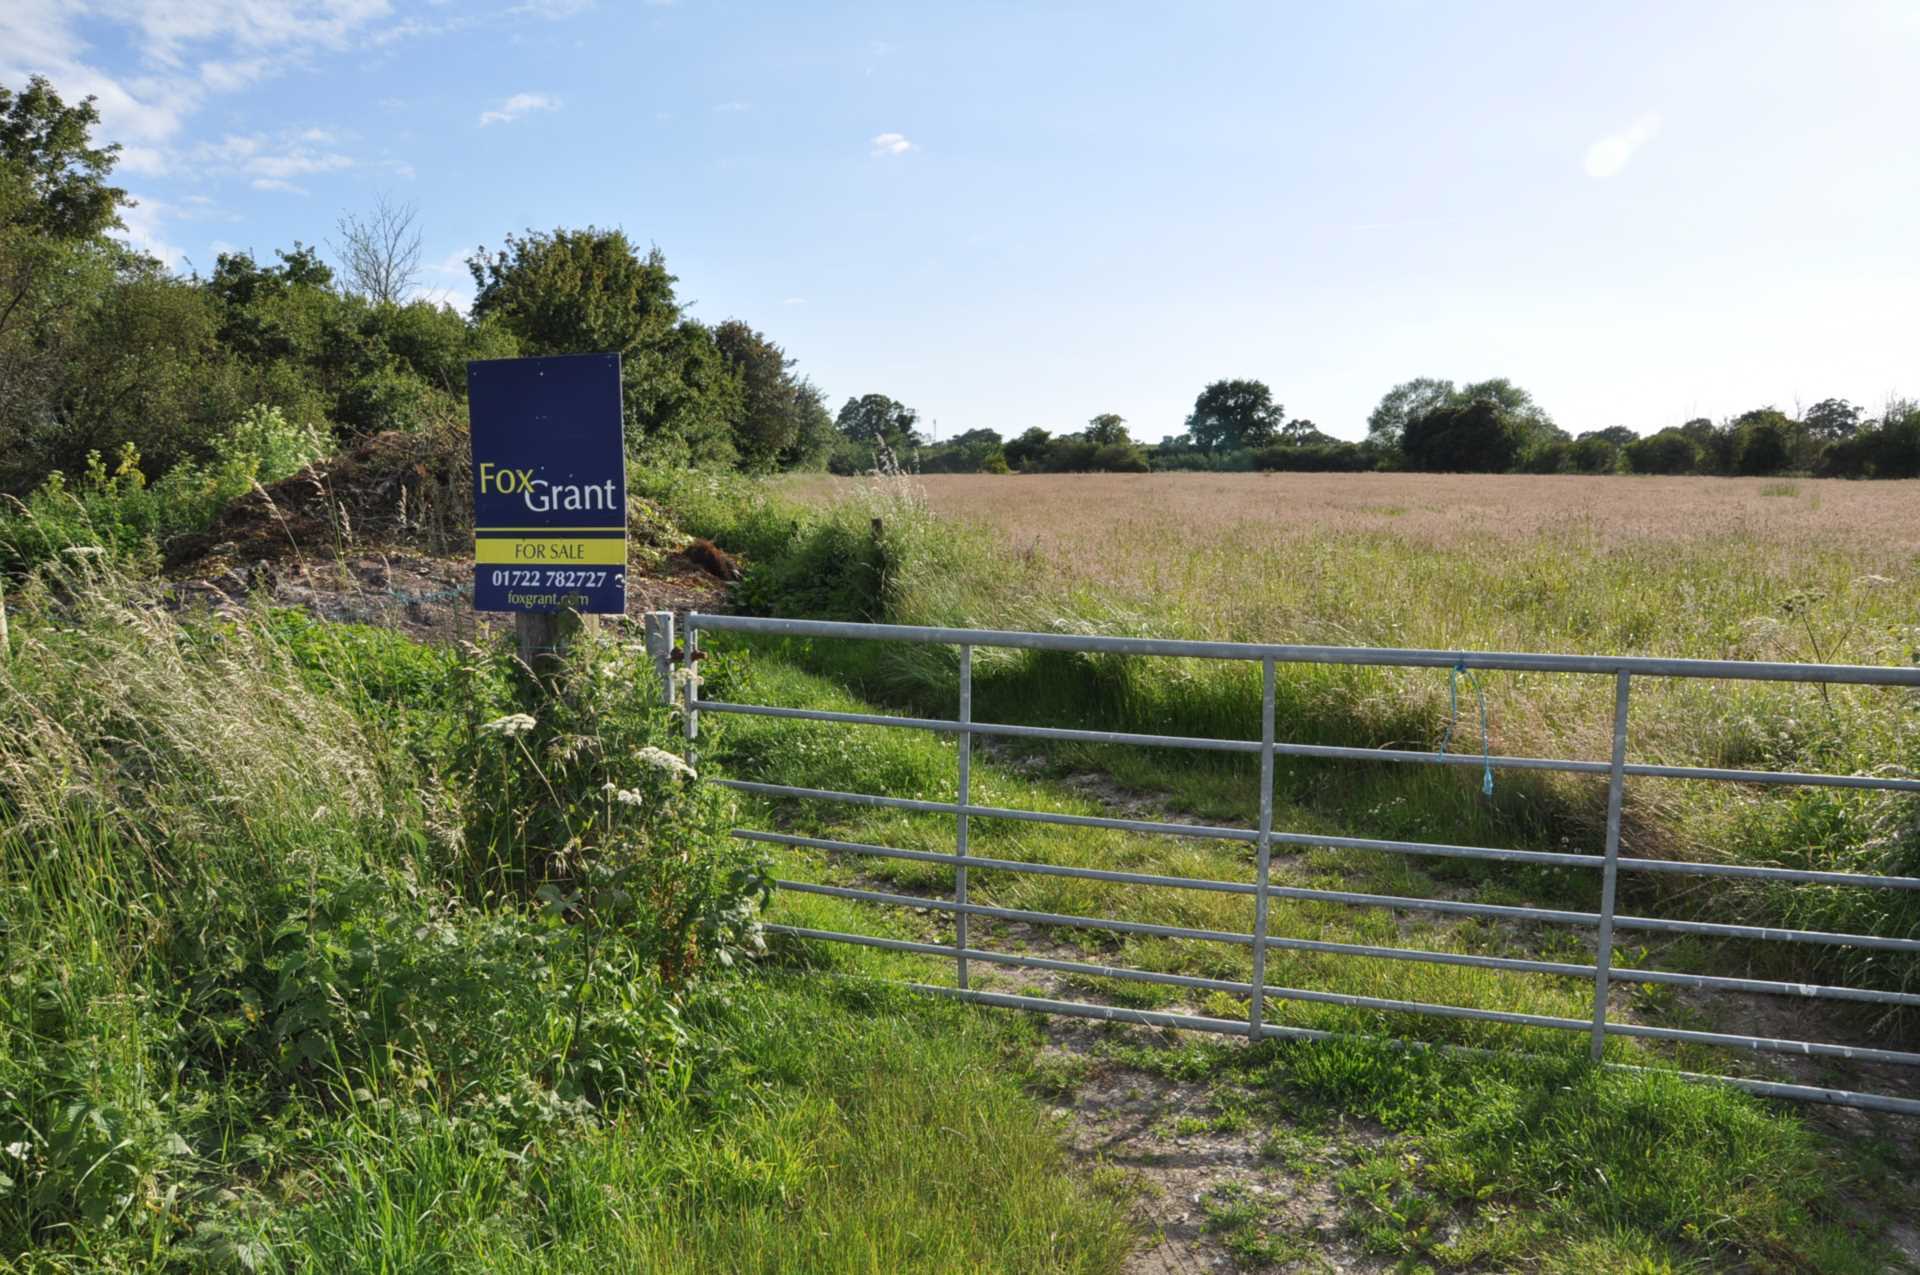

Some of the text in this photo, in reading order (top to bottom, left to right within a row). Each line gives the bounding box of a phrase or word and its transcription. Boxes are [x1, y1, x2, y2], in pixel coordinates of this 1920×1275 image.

[479, 462, 617, 512] Fox Grant
[515, 543, 585, 560] FOR SALE
[492, 570, 607, 588] 01722 782727
[507, 590, 590, 609] foxgrant.cm
